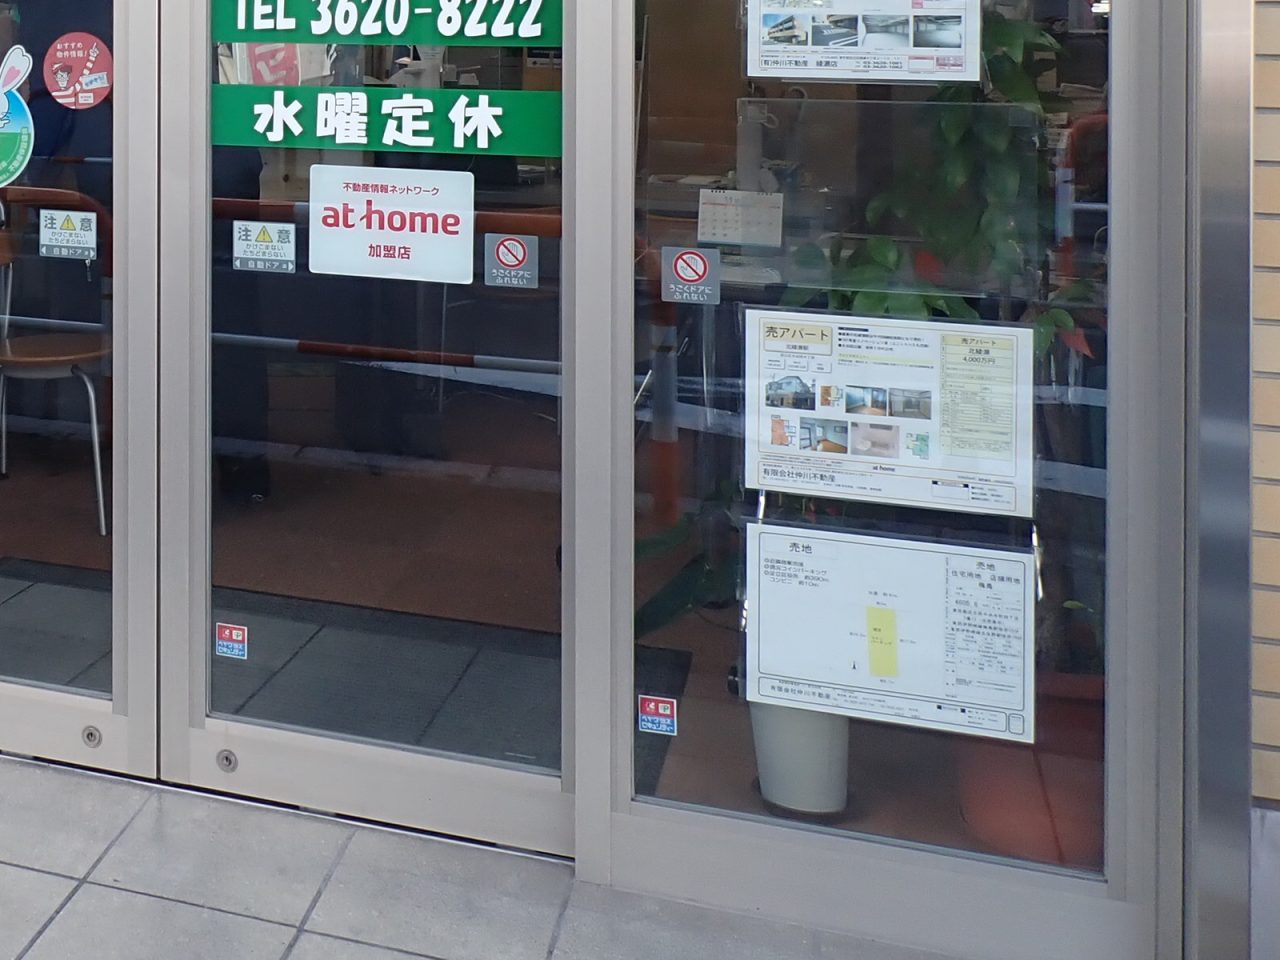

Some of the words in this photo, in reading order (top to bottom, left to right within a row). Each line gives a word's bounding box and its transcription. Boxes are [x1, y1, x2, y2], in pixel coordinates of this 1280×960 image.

[56, 42, 83, 50] おすすめ
[253, 92, 505, 149] 水曜定休
[343, 182, 440, 196] 不動産情報ネットワーク
[321, 202, 356, 229] at
[359, 199, 461, 236] home
[368, 244, 411, 260] 加盟店
[491, 269, 532, 279] うごくドアに
[496, 277, 527, 286] ふれない
[669, 284, 713, 294] うごくドアに
[674, 293, 708, 301] ふれない
[765, 326, 829, 341] 売アパート
[788, 542, 813, 554] 売地
